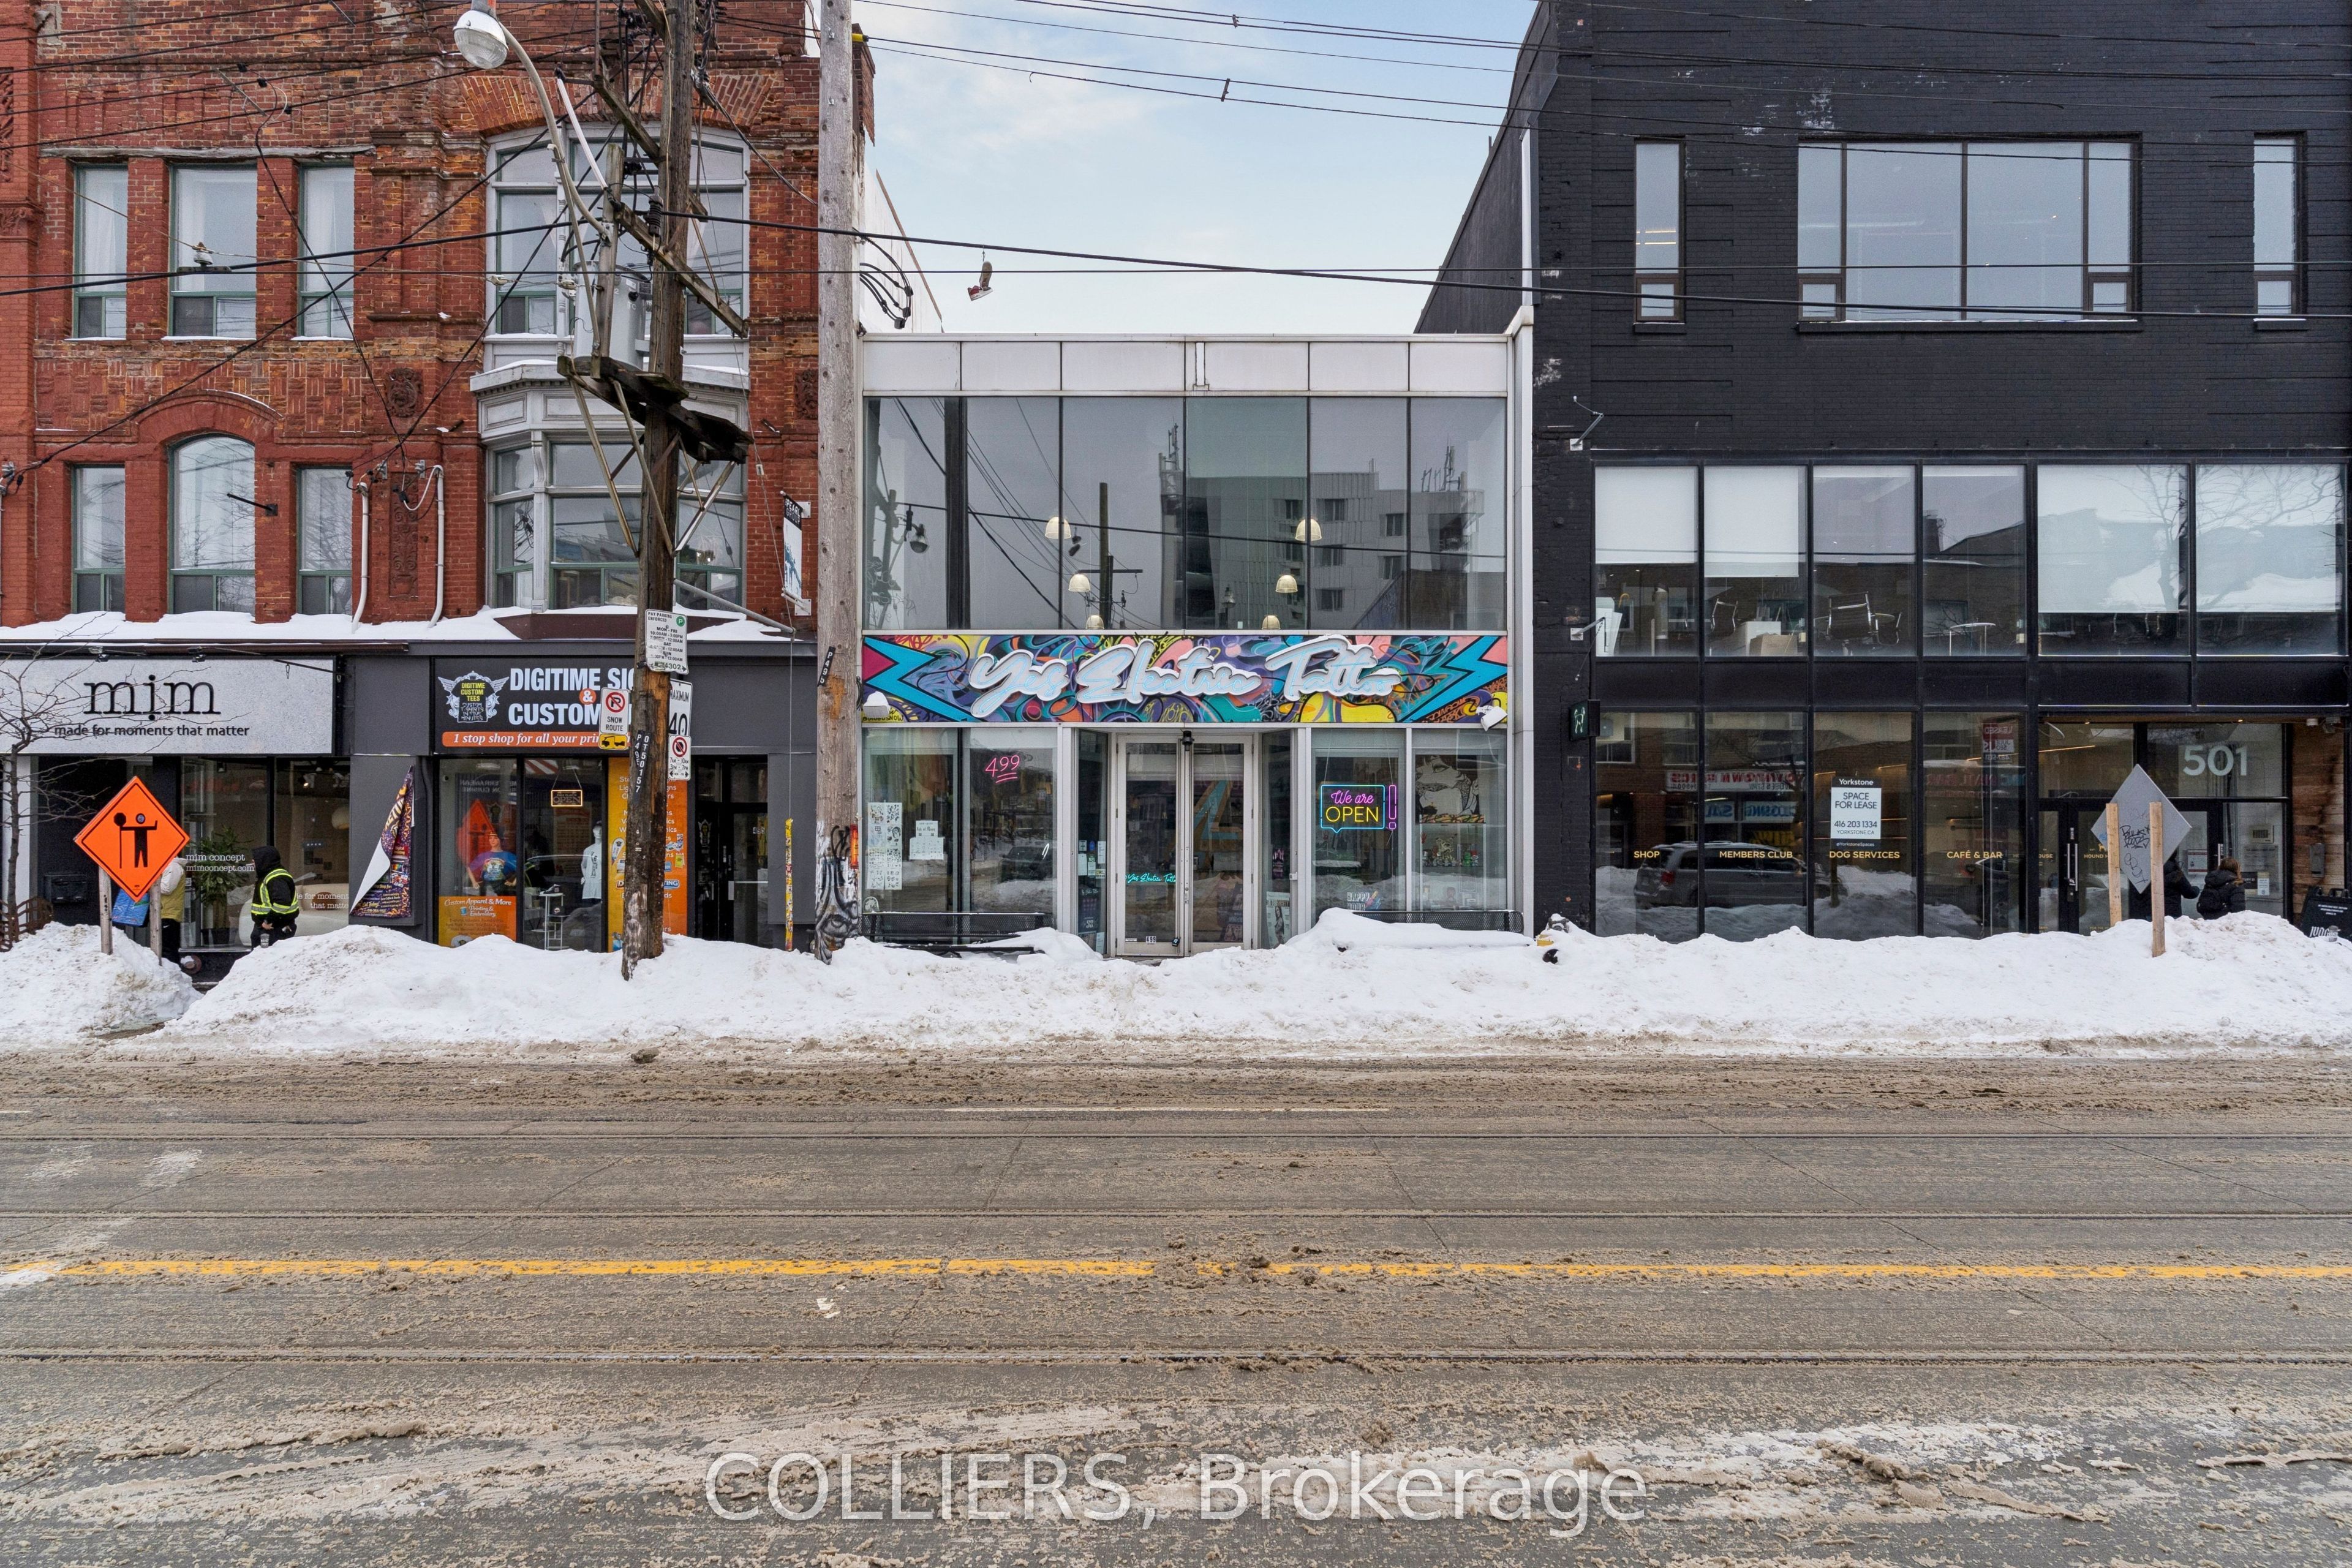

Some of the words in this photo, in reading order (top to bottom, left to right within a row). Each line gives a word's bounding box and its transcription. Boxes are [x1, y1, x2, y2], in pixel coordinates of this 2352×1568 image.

[510, 668, 601, 691] DIGITIME
[968, 649, 1069, 717] Yes
[1075, 638, 1262, 704] Electric
[1265, 634, 1401, 701] Tattoo
[582, 690, 593, 703] &
[669, 712, 688, 735] 40
[54, 725, 88, 736] made
[92, 725, 111, 736] for
[114, 726, 173, 736] moments
[177, 725, 201, 736] that
[206, 726, 249, 736] matter
[453, 733, 459, 744] 1
[462, 734, 486, 745] stop
[488, 733, 513, 745] shop
[517, 733, 533, 746] for
[535, 733, 549, 744] all
[552, 735, 578, 746] your
[985, 755, 1020, 777] 499
[2183, 745, 2247, 776] 501
[1330, 790, 1352, 804] We
[1354, 793, 1374, 804] are
[1843, 792, 1870, 801] SPACE
[1835, 801, 1852, 809] FOR
[1325, 806, 1379, 822] OPEN
[209, 854, 246, 862] concept
[1947, 850, 1971, 859] CAFÉ
[186, 864, 255, 873] mimconcept.com
[1163, 873, 1176, 883] Tatt
